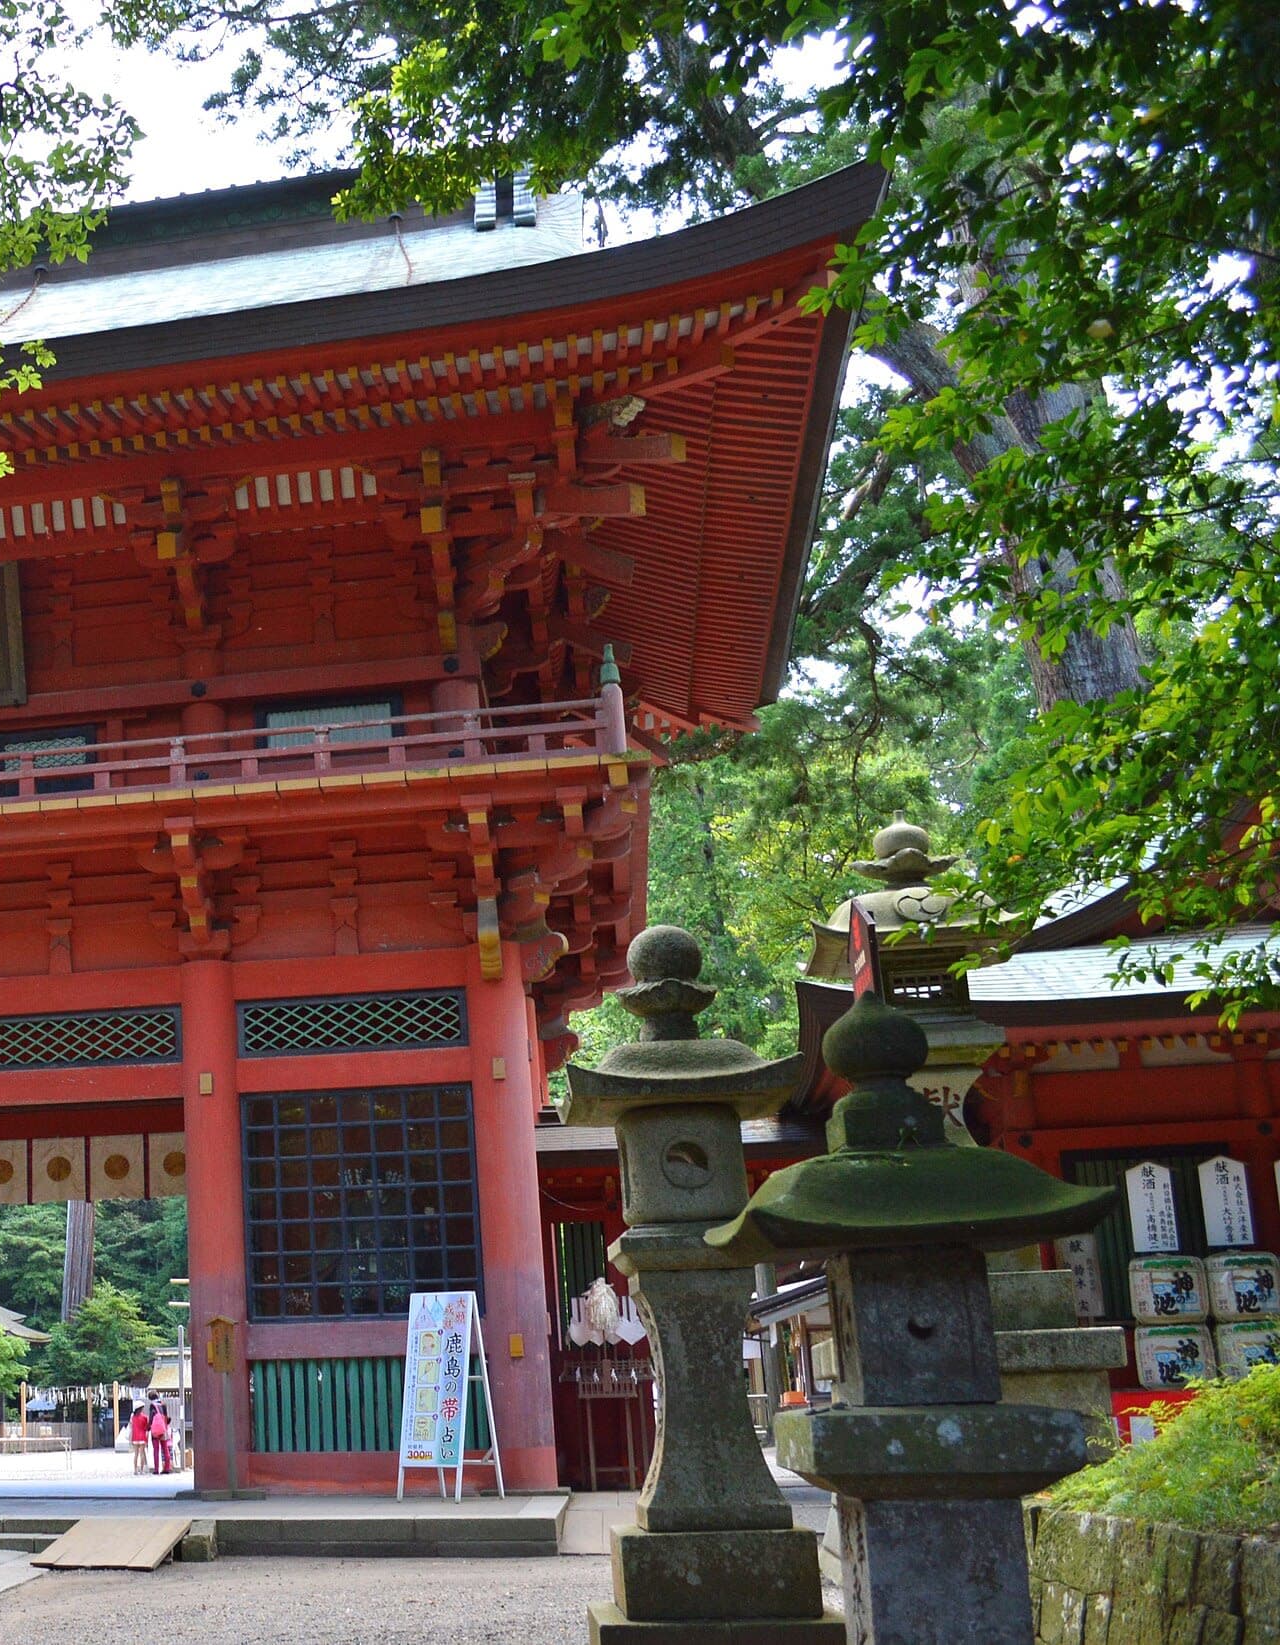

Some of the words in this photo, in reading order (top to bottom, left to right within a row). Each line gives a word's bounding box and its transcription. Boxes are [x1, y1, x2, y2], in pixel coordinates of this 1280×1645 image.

[1141, 1166, 1156, 1189] 献酒
[1214, 1160, 1229, 1185] 献酒
[439, 1332, 464, 1460] 鹿島の帯占い
[407, 1450, 433, 1460] 300円
